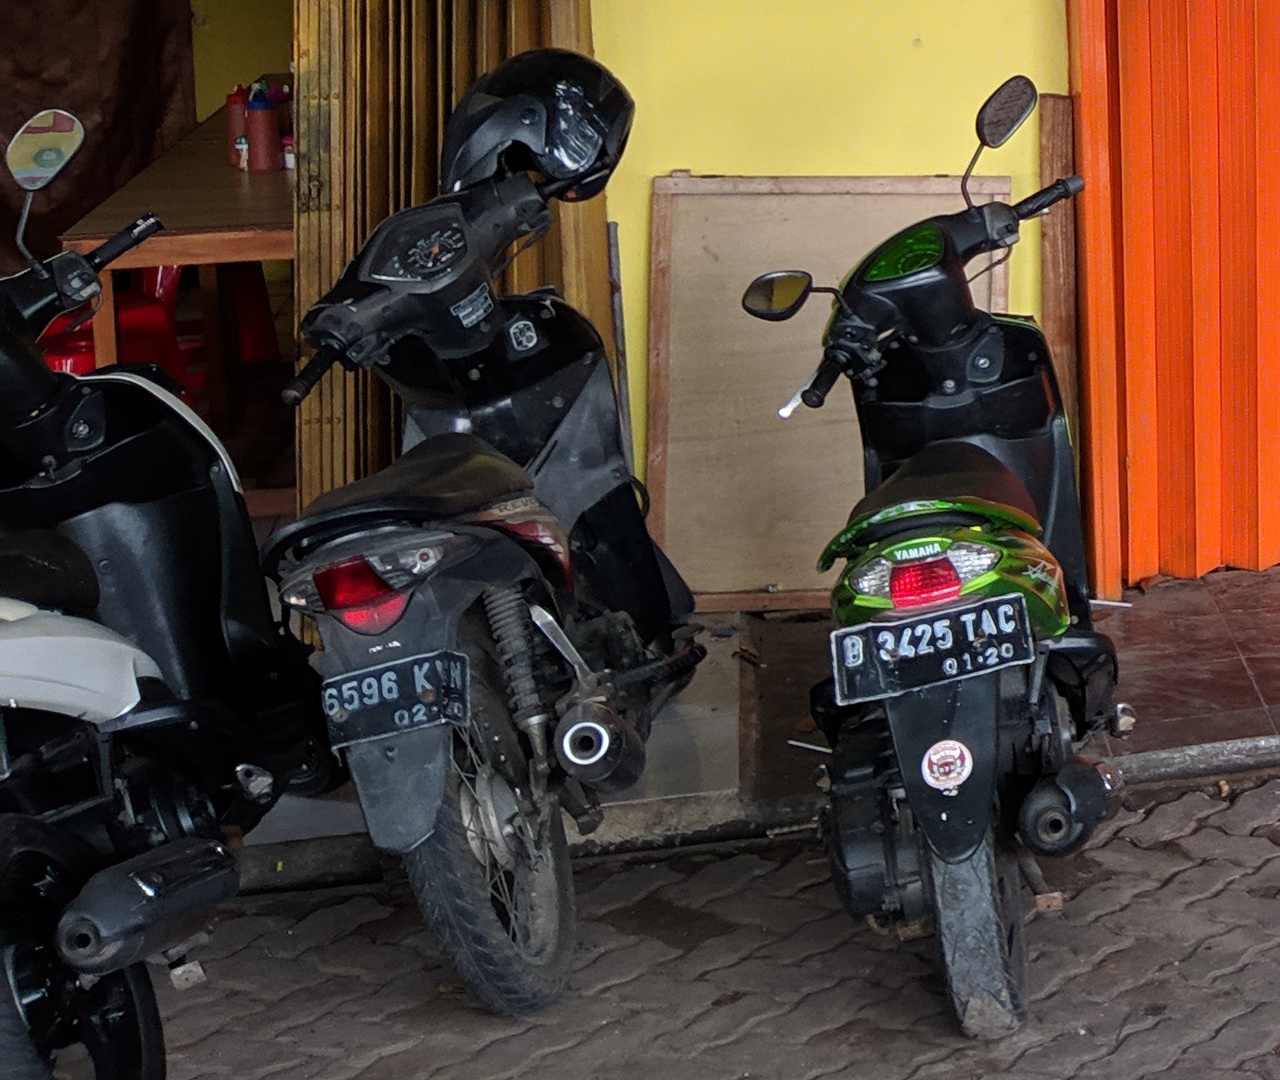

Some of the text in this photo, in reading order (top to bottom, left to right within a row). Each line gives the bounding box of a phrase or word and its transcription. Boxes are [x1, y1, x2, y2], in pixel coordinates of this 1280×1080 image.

[894, 542, 942, 561] YAMAHA
[843, 635, 863, 668] B
[960, 604, 1017, 642] TAC
[323, 671, 399, 716] 6596
